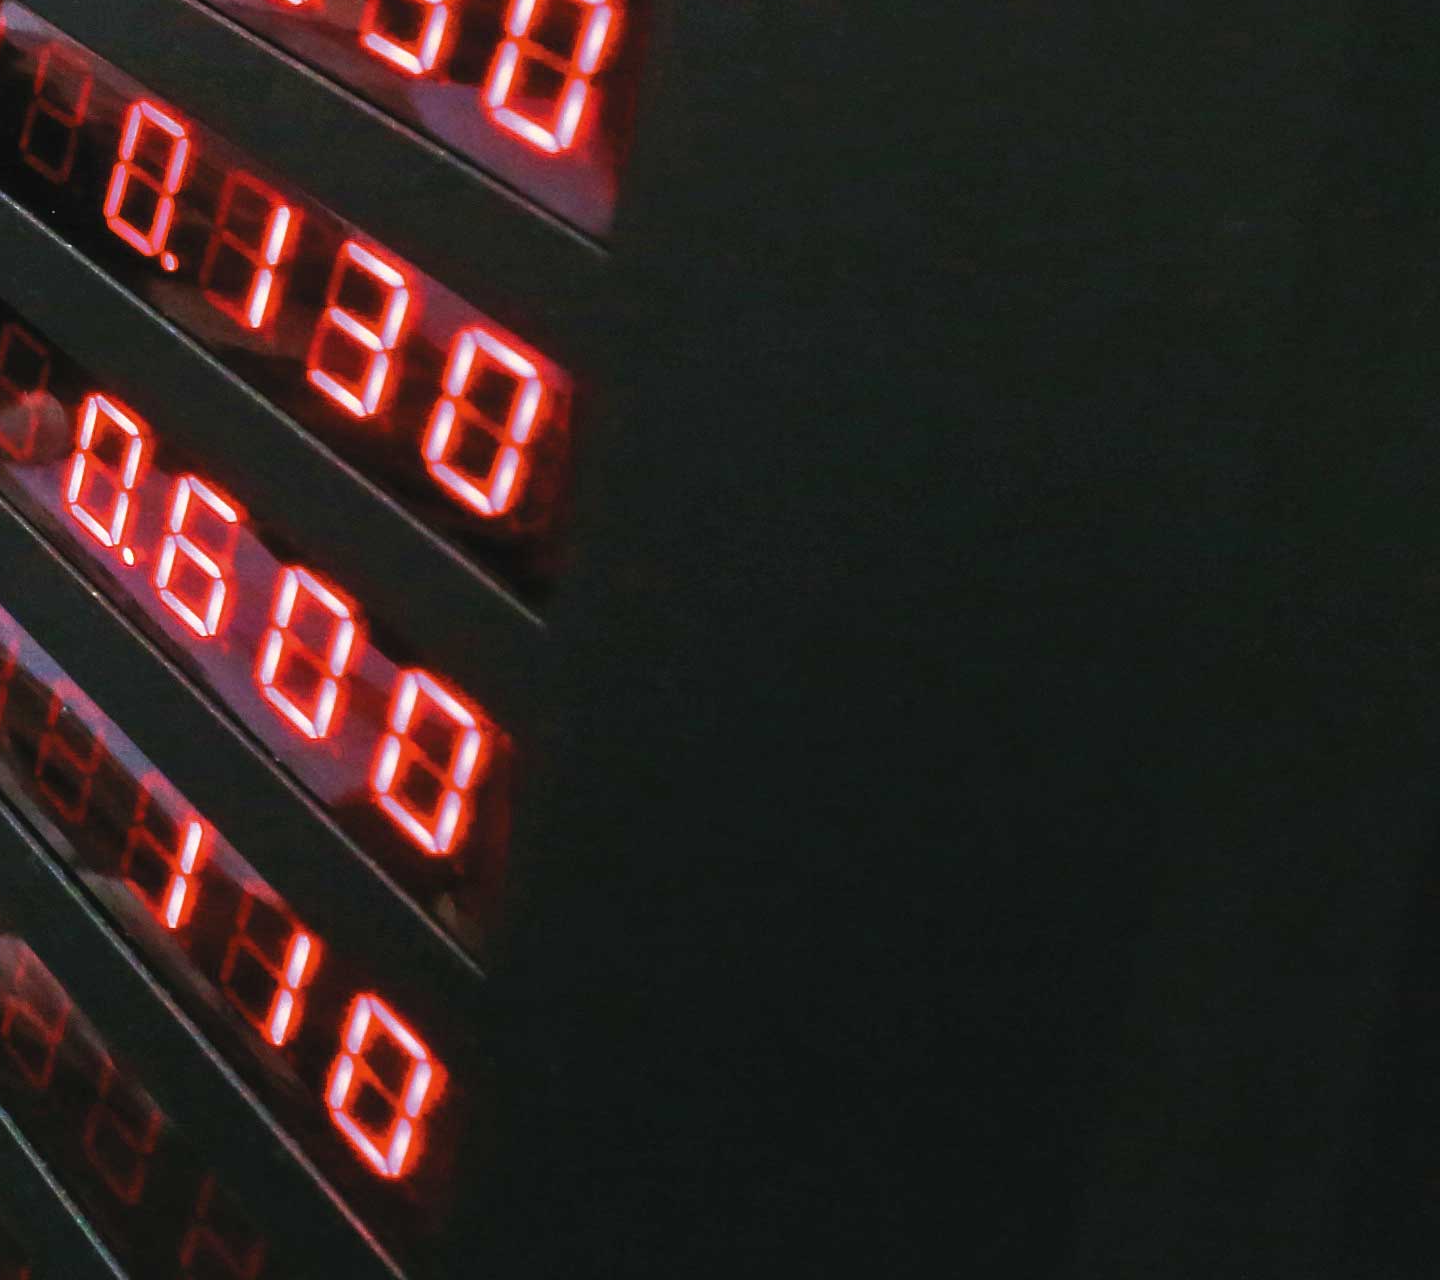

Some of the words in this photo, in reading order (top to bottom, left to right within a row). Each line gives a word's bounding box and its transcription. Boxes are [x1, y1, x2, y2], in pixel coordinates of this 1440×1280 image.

[103, 99, 545, 518] 0.130
[67, 394, 482, 855] 0.600
[163, 820, 438, 1178] 110
